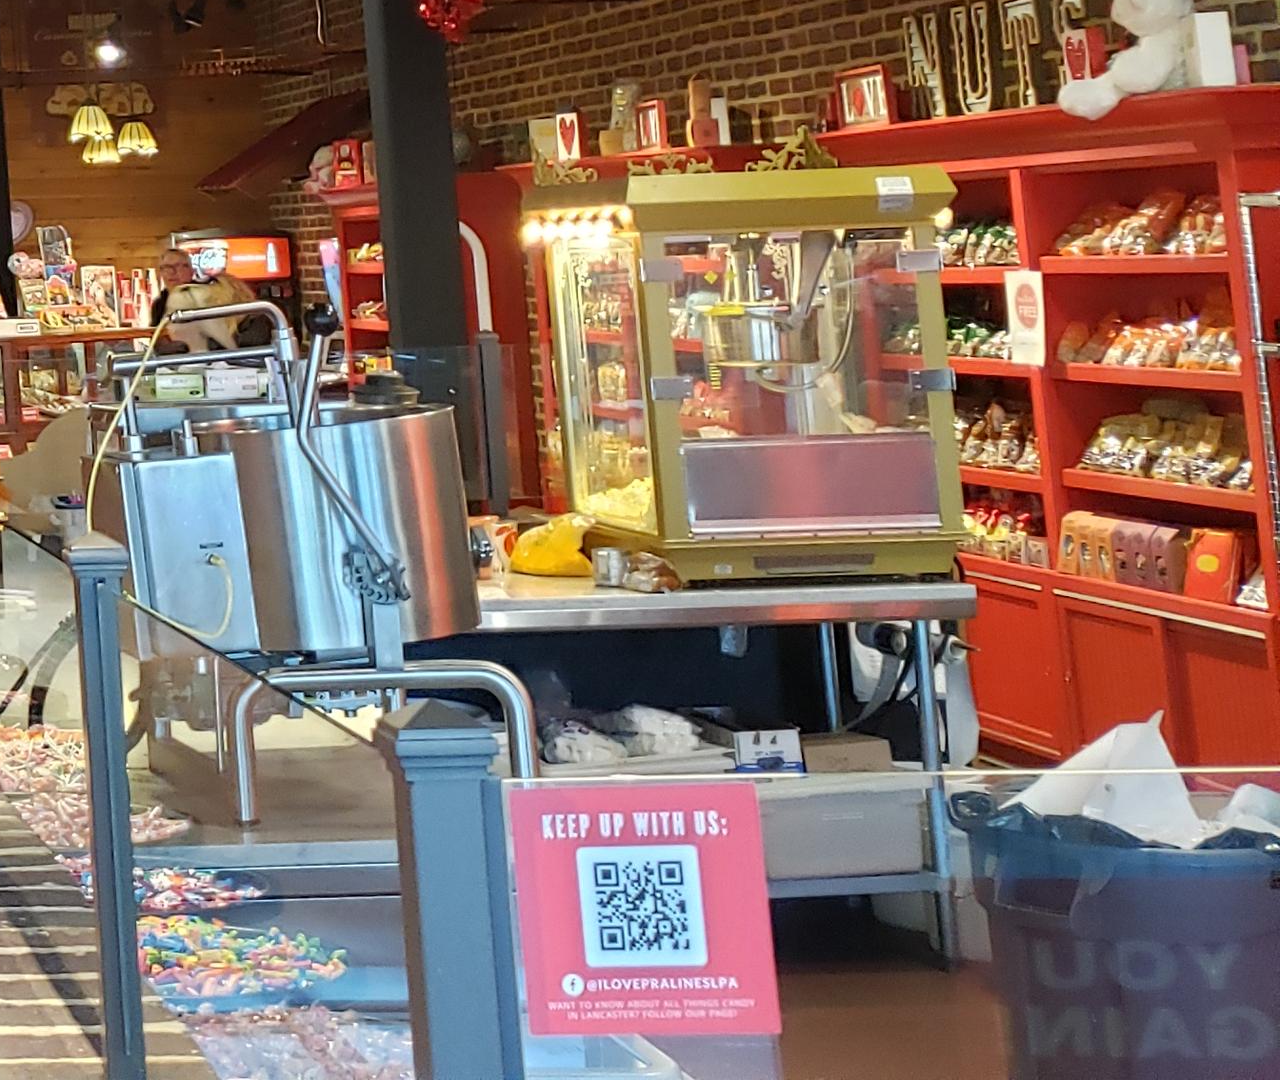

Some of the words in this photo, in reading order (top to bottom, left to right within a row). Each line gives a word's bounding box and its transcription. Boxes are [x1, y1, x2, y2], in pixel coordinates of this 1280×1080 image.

[541, 814, 590, 839] KEEP
[598, 812, 625, 837] UP
[633, 811, 685, 837] WITH
[693, 809, 728, 837] US:
[586, 976, 739, 993] @ILOVEPRALINESLPA
[548, 1001, 576, 1011] WANT
[578, 1000, 593, 1010] TO
[594, 999, 624, 1009] KNOW
[627, 999, 660, 1009] ABOUT
[663, 999, 680, 1008] ALL
[683, 998, 719, 1008] THINGS
[721, 998, 756, 1008] CANDY
[567, 1012, 579, 1021] IN
[642, 1009, 682, 1020] FOLLOW
[684, 1009, 707, 1019] OUR
